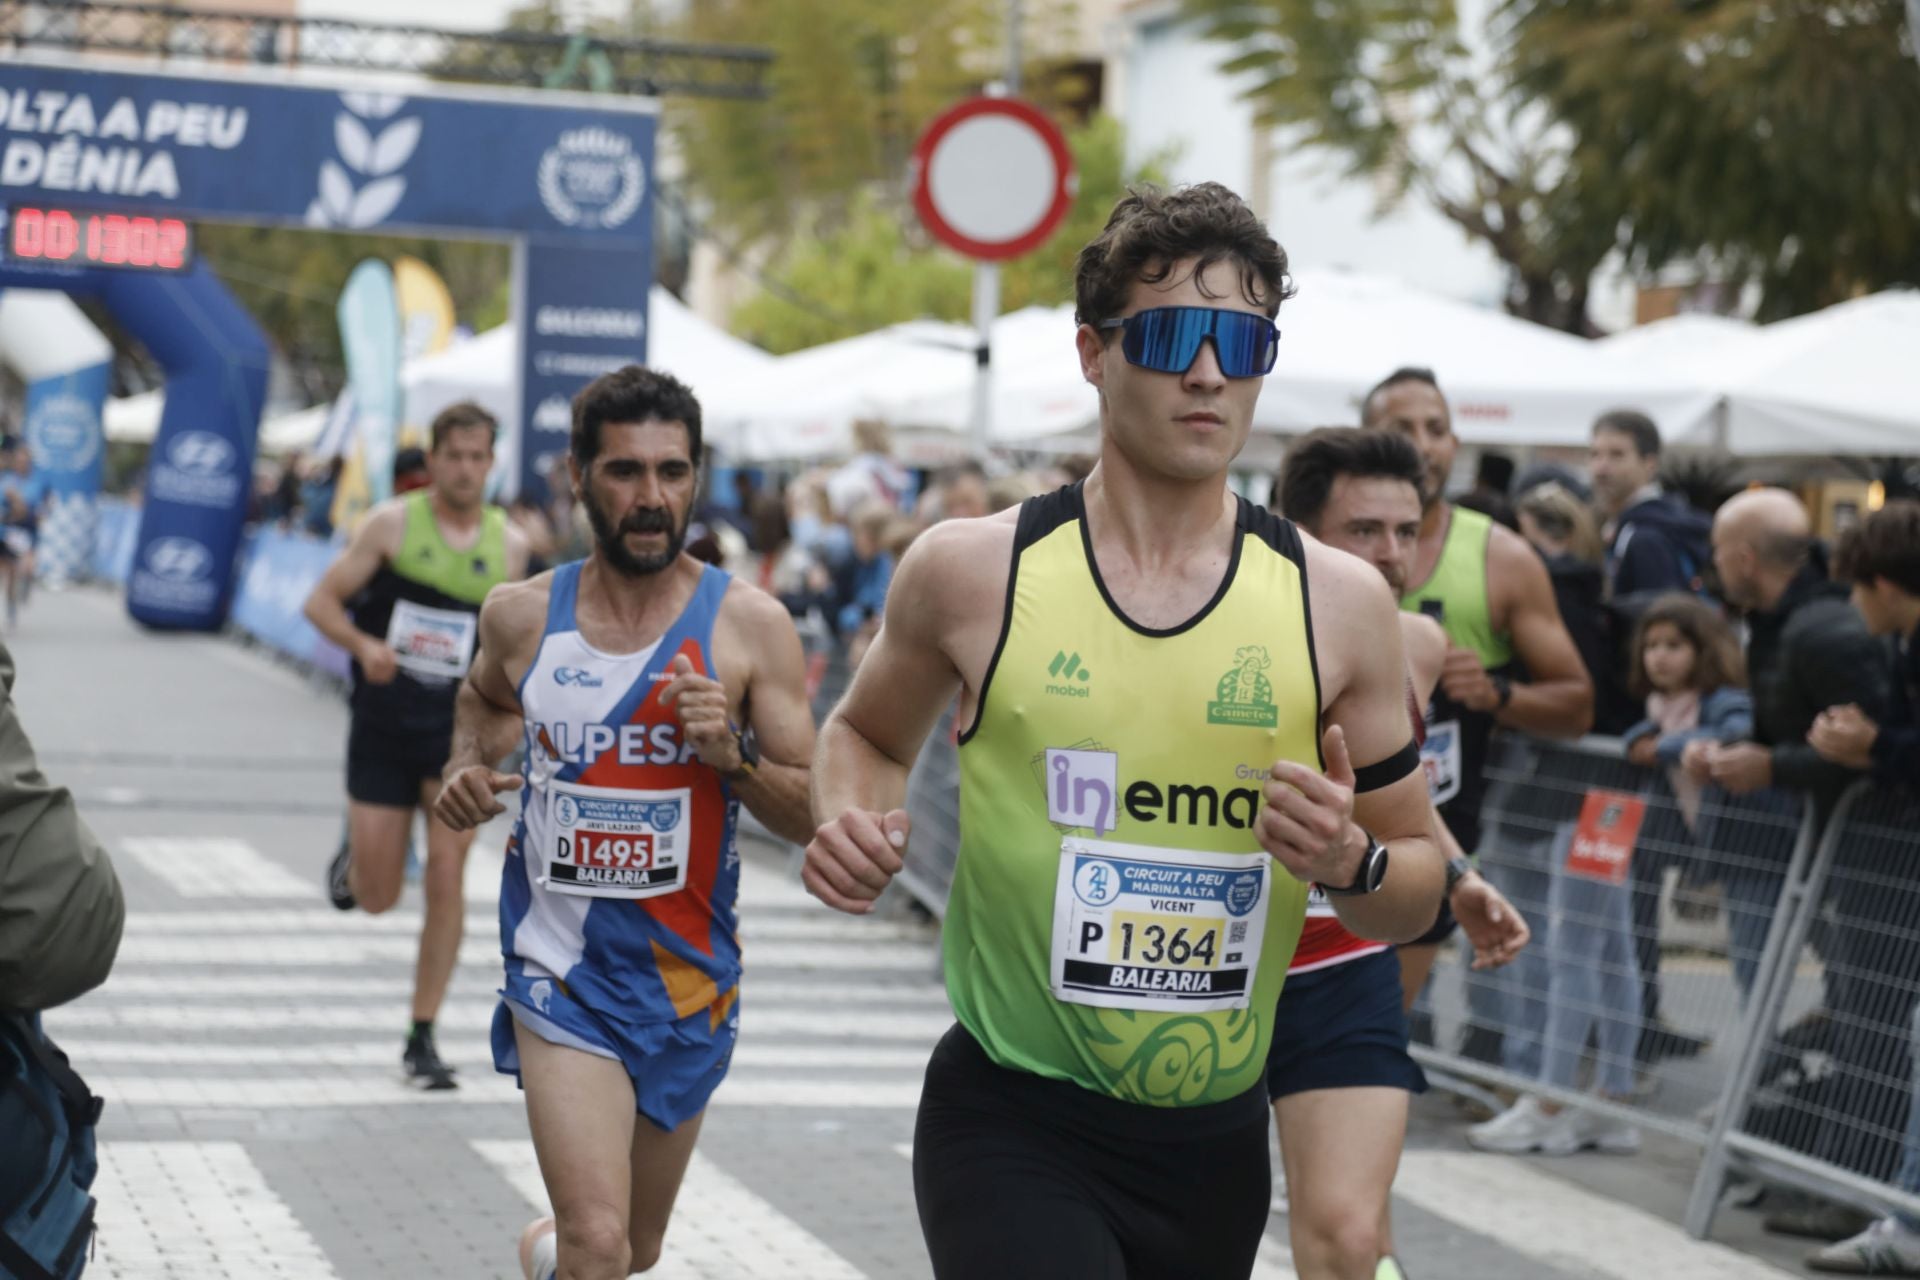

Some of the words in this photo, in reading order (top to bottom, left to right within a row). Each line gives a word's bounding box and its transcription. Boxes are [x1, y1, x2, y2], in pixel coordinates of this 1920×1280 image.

[0, 87, 97, 137] LTA
[100, 97, 140, 141] A
[143, 99, 248, 149] PEU
[1, 134, 181, 199] DÉNIA
[1045, 683, 1090, 698] mobel
[558, 836, 571, 858] D
[580, 837, 649, 867] 1495
[1124, 867, 1182, 883] CIRCUIT
[1182, 872, 1193, 882] A
[1195, 873, 1225, 886] PEU
[1132, 881, 1180, 896] MARINA
[1183, 886, 1215, 898] ALTA
[1151, 899, 1195, 913] VICENT
[1079, 921, 1104, 954] P
[1121, 923, 1215, 966] 1364
